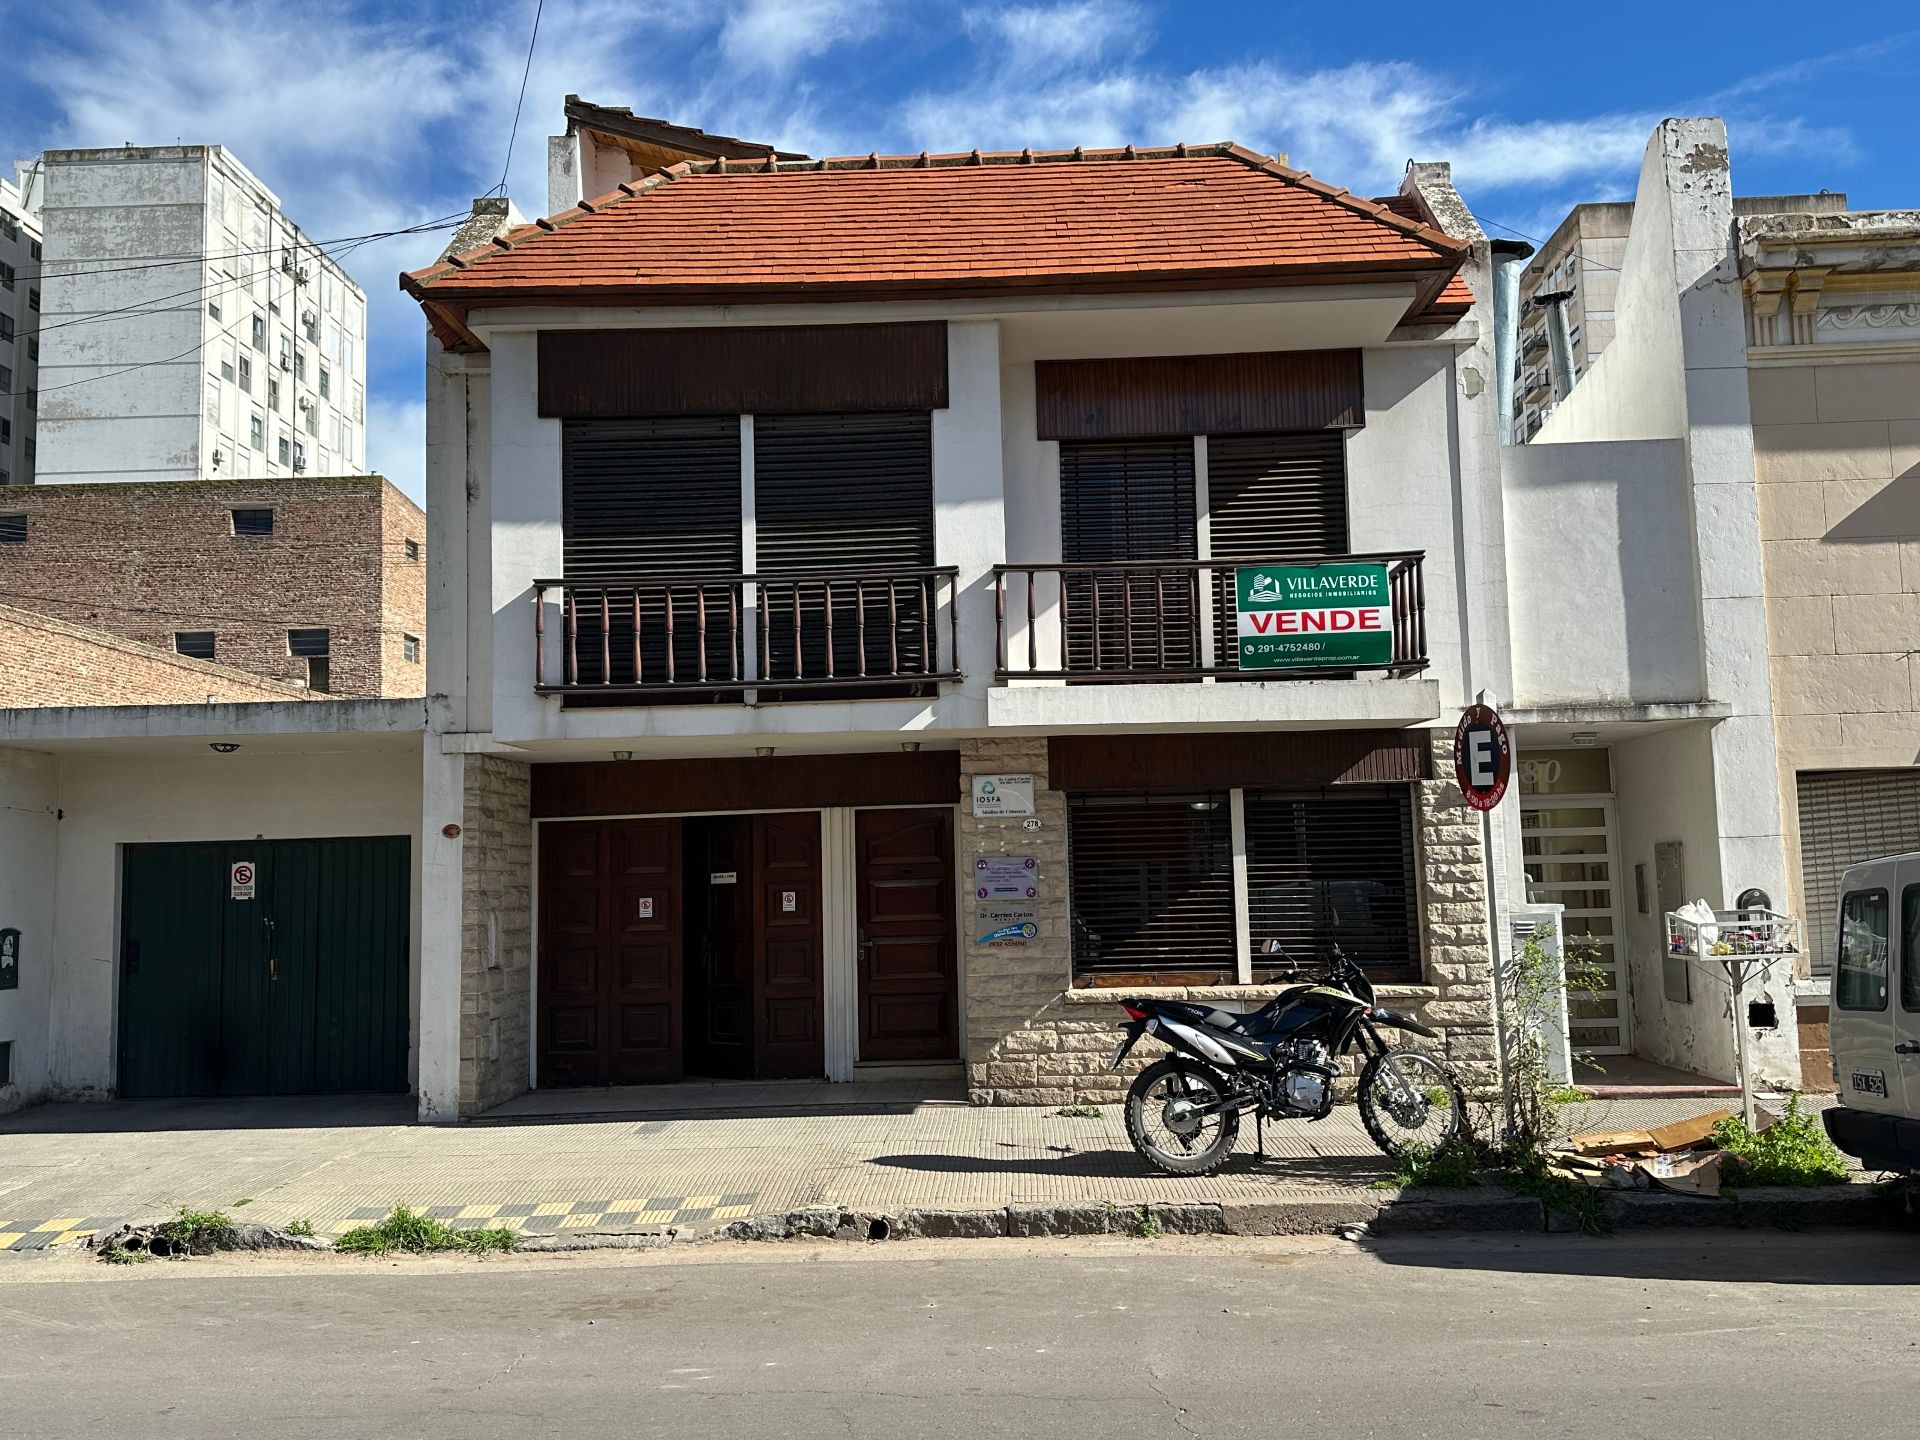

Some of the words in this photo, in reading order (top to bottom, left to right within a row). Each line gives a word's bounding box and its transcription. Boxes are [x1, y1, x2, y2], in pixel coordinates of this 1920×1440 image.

[1286, 574, 1378, 590] VILLAVERDE
[1249, 609, 1382, 634] VENDE
[1257, 642, 1321, 653] 291-4752480
[1273, 655, 1360, 663] www.villaverdeprop.com.ar
[1490, 713, 1508, 755] Pago
[1468, 730, 1494, 786] E
